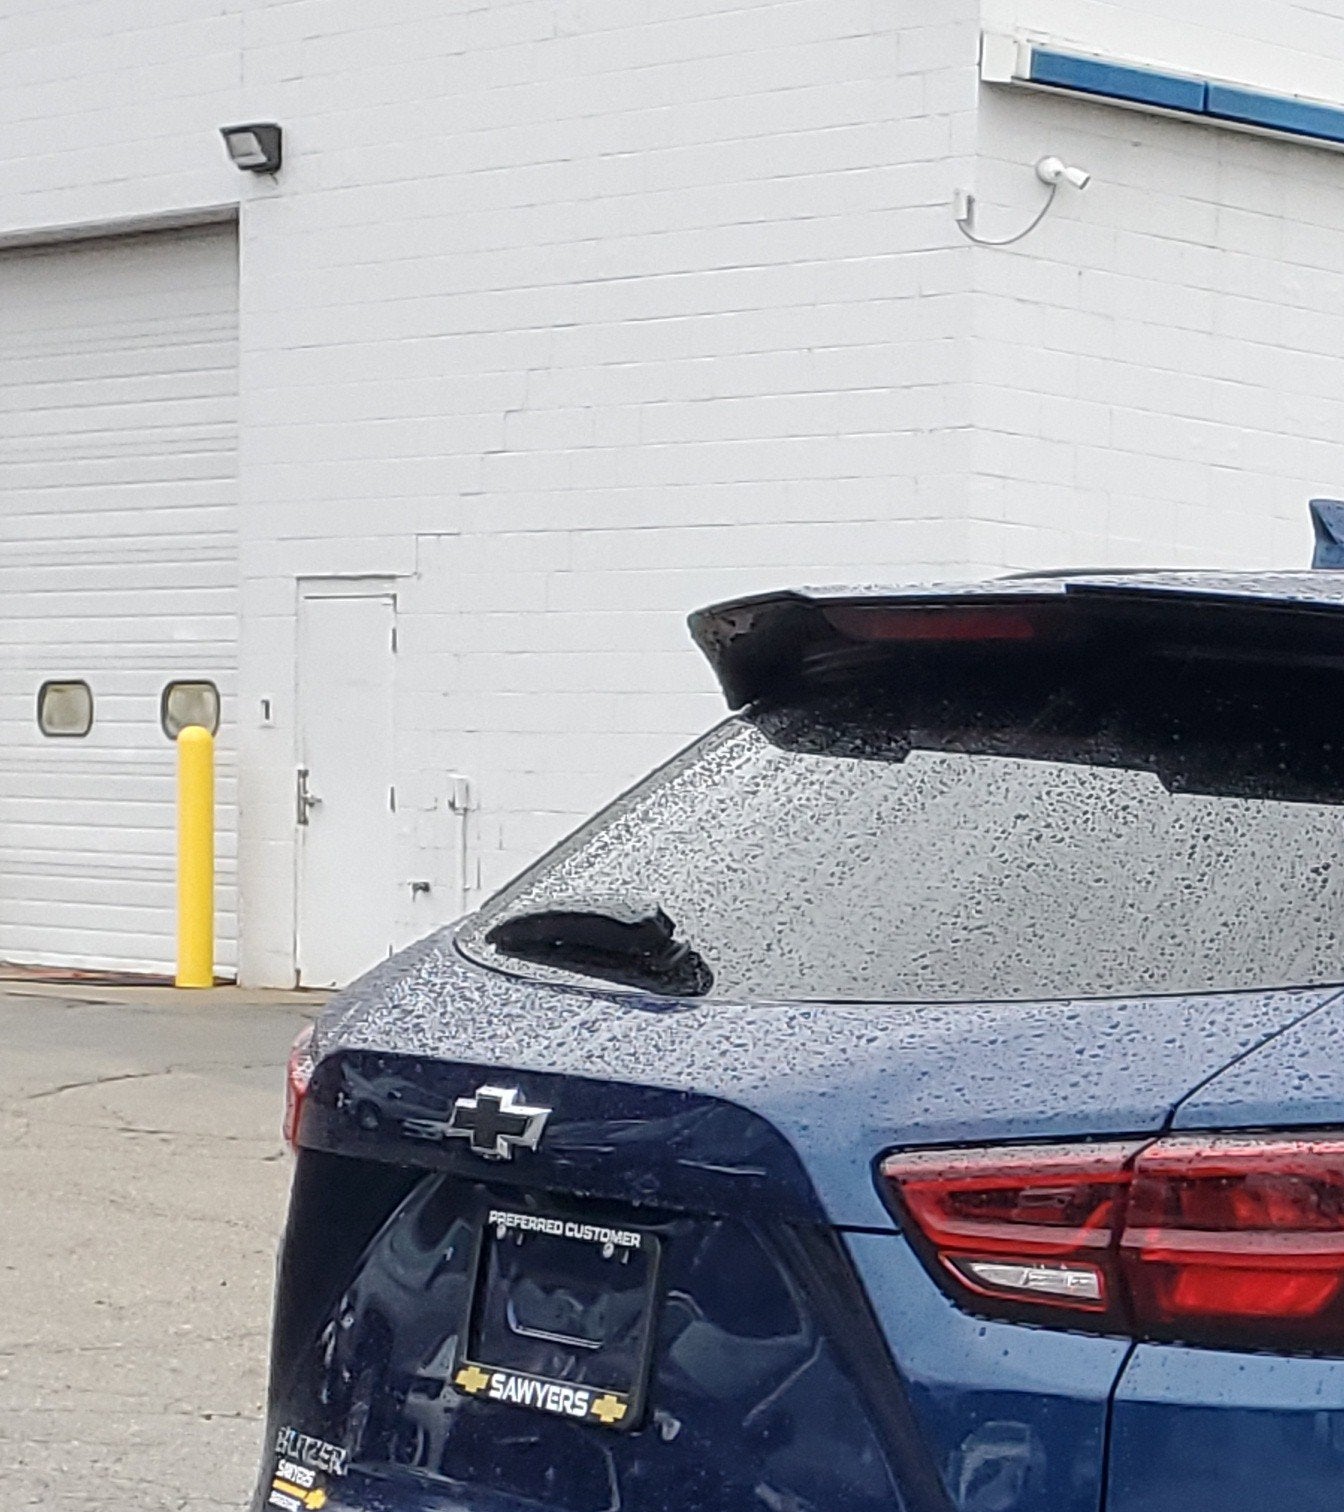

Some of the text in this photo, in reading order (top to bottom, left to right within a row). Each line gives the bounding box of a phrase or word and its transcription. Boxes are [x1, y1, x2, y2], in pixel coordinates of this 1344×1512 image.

[488, 1210, 641, 1248] PREFERRED CUSTOMER
[488, 1372, 590, 1418] SAWYERS
